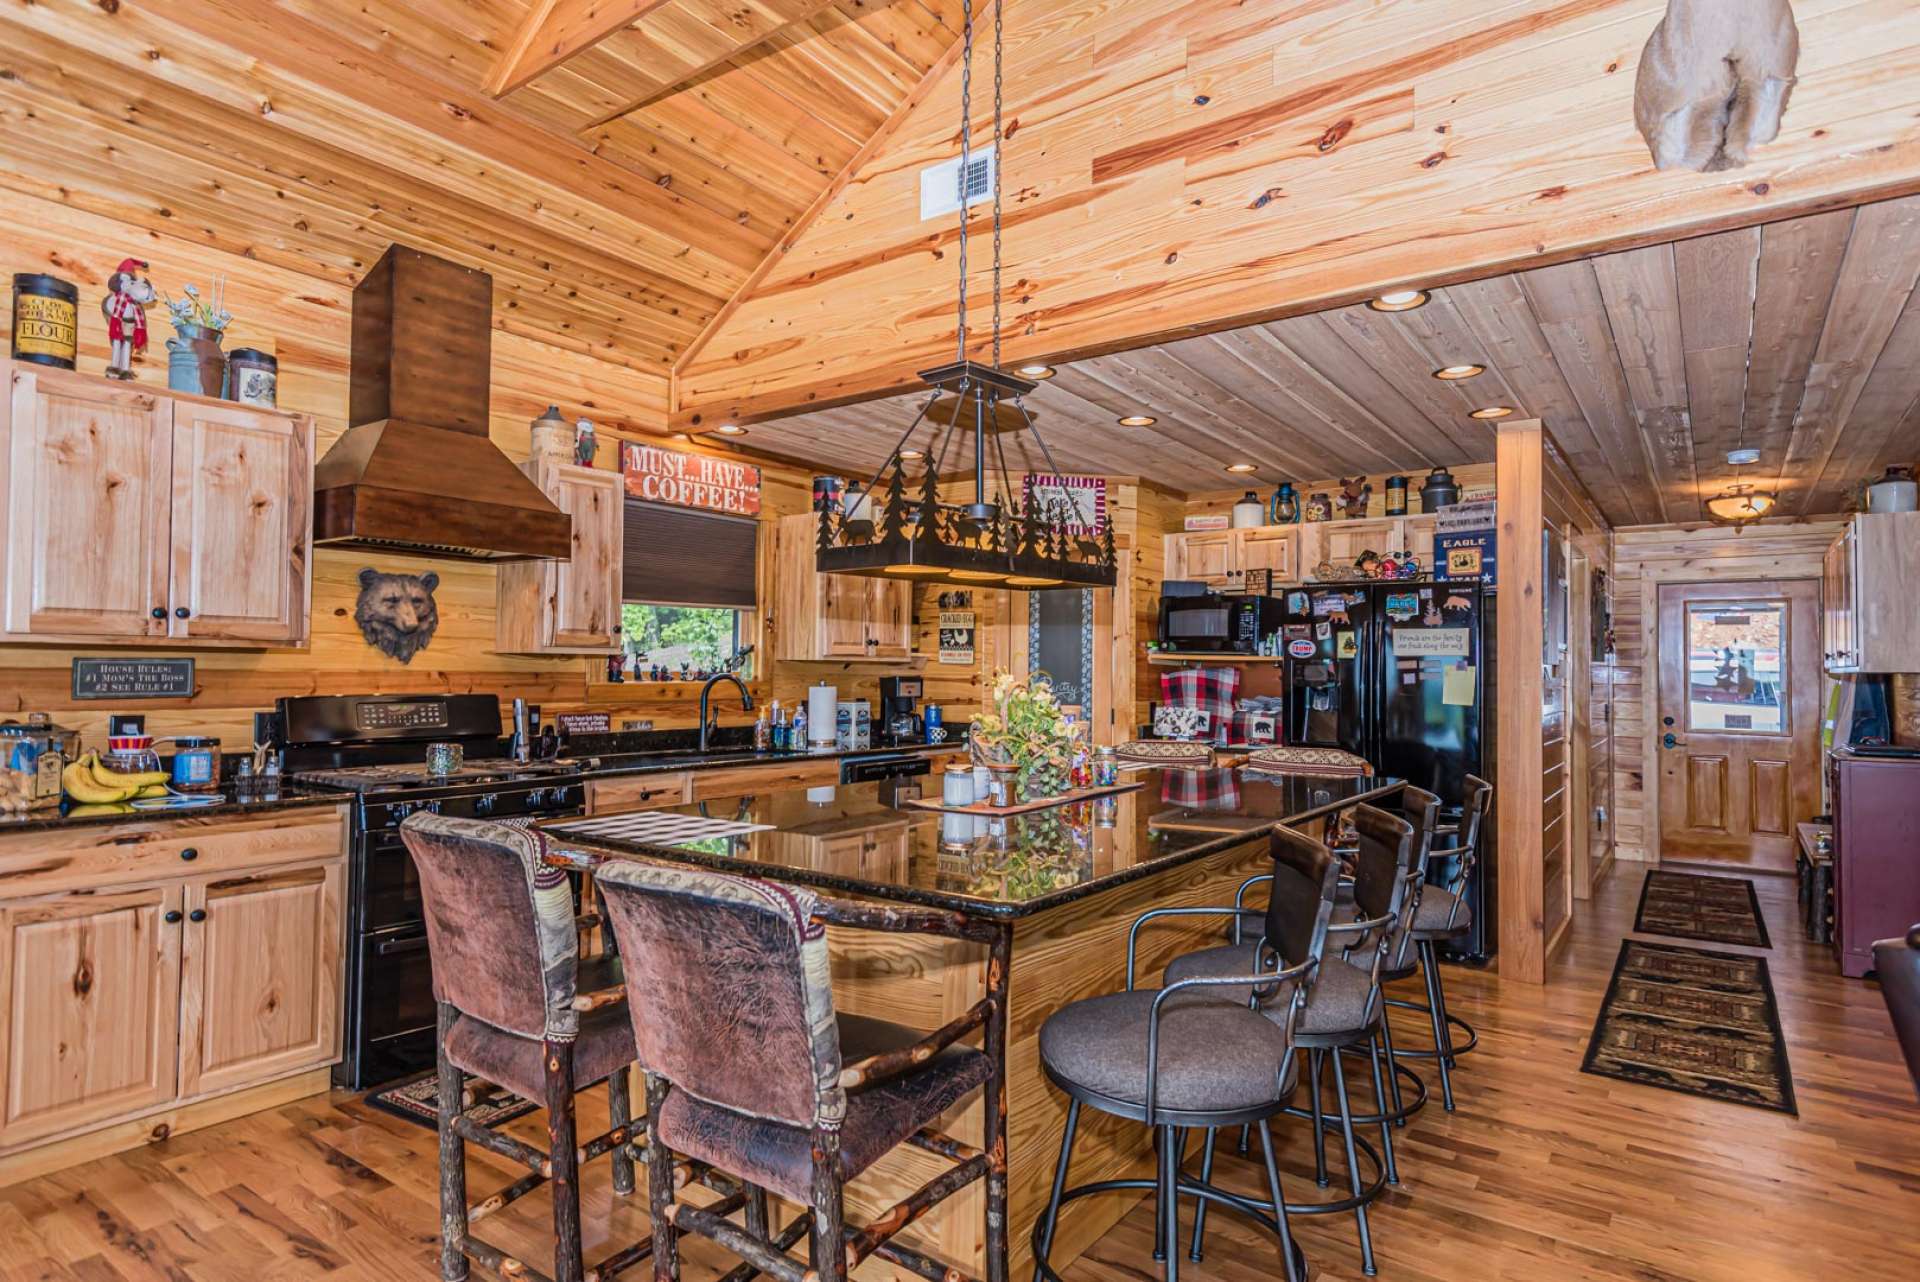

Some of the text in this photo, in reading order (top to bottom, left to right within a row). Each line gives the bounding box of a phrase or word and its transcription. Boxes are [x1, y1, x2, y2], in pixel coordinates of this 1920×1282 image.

[22, 321, 73, 343] FLOUR
[642, 474, 745, 512] COFFEE!
[1442, 538, 1487, 549] EAGLE
[1292, 645, 1312, 653] TRUMP
[100, 664, 134, 673] HOUSE
[85, 673, 184, 682] #1 MOM'S THE BOSS
[95, 682, 174, 692] #2 SEE RULE #1
